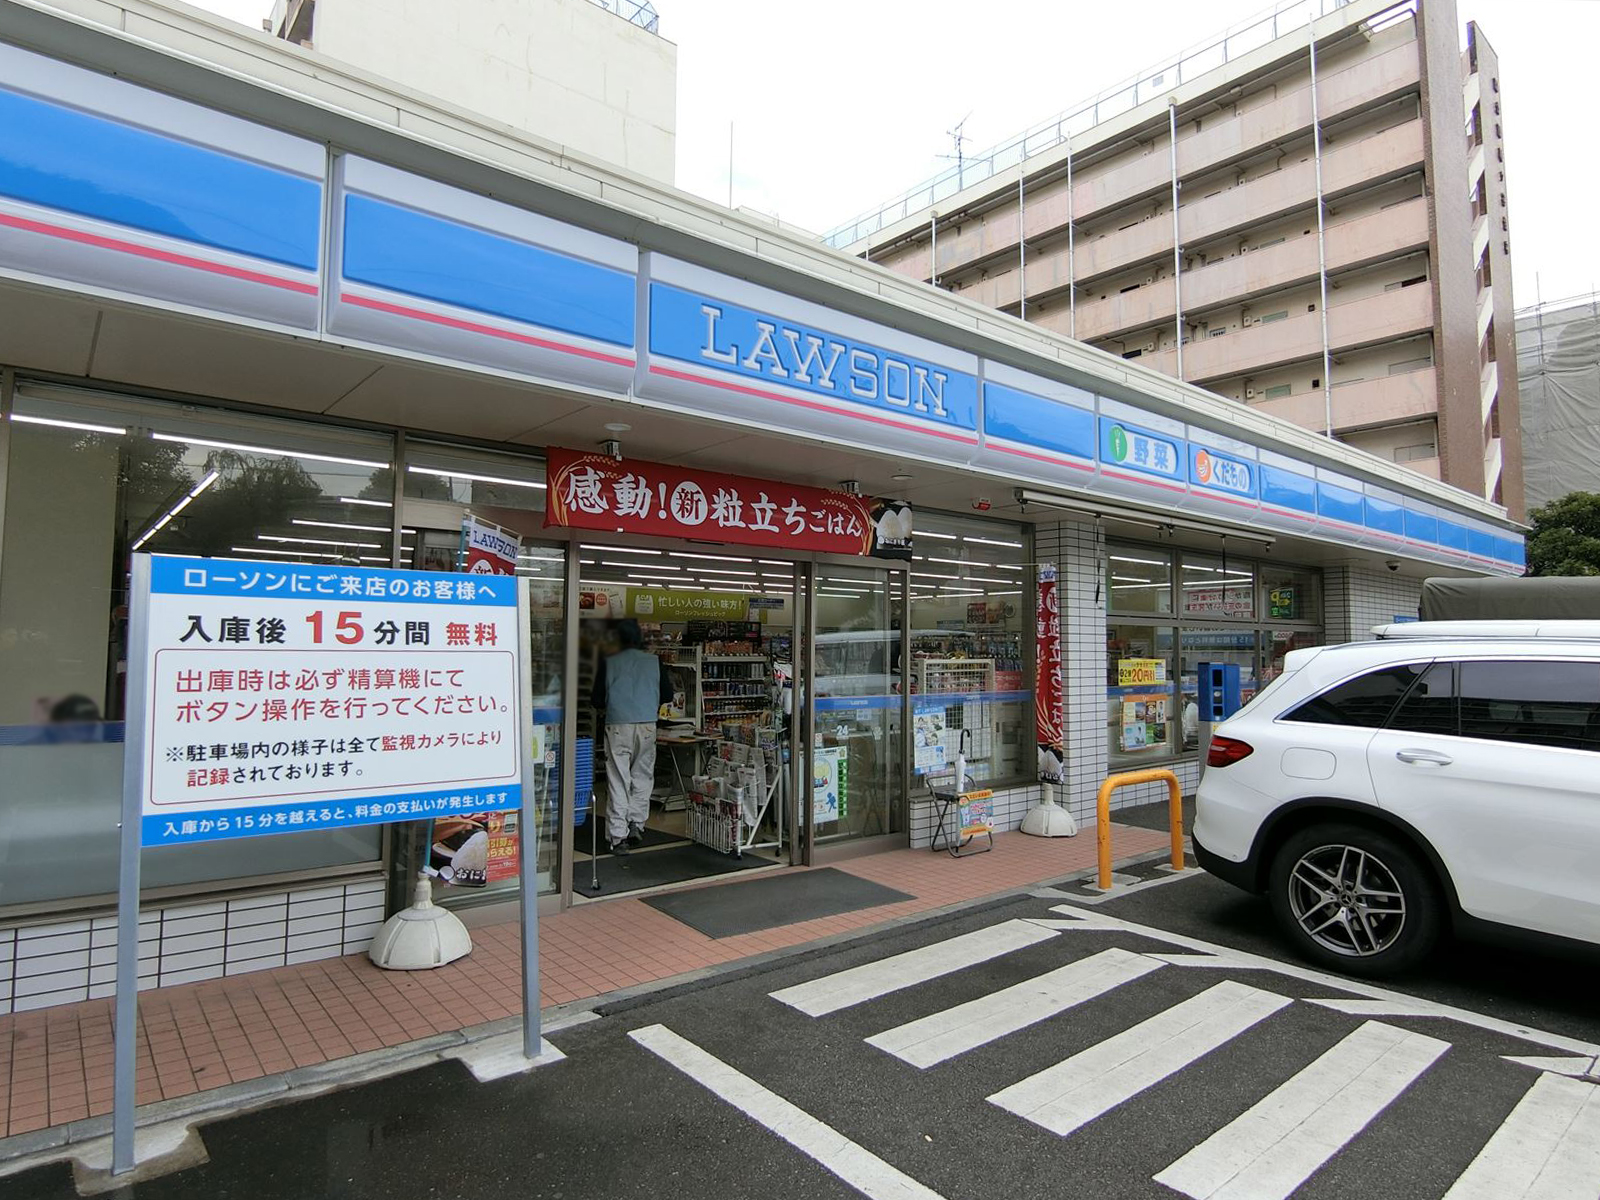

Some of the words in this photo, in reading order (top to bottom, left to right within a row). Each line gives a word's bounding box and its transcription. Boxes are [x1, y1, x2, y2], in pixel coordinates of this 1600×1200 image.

[701, 305, 948, 417] LAWSON
[1133, 436, 1169, 469] 野菜
[1213, 460, 1247, 490] くだもの
[473, 530, 518, 560] LAWSON
[184, 568, 497, 600] ローソンにご来店のお客様へ
[179, 615, 287, 644] 入庫後
[446, 621, 498, 646] 無料
[176, 668, 464, 693] 出庫時は必ず精算機にて
[176, 694, 508, 723] ボタン操作を行ってください。
[187, 760, 363, 788] 記録されております。
